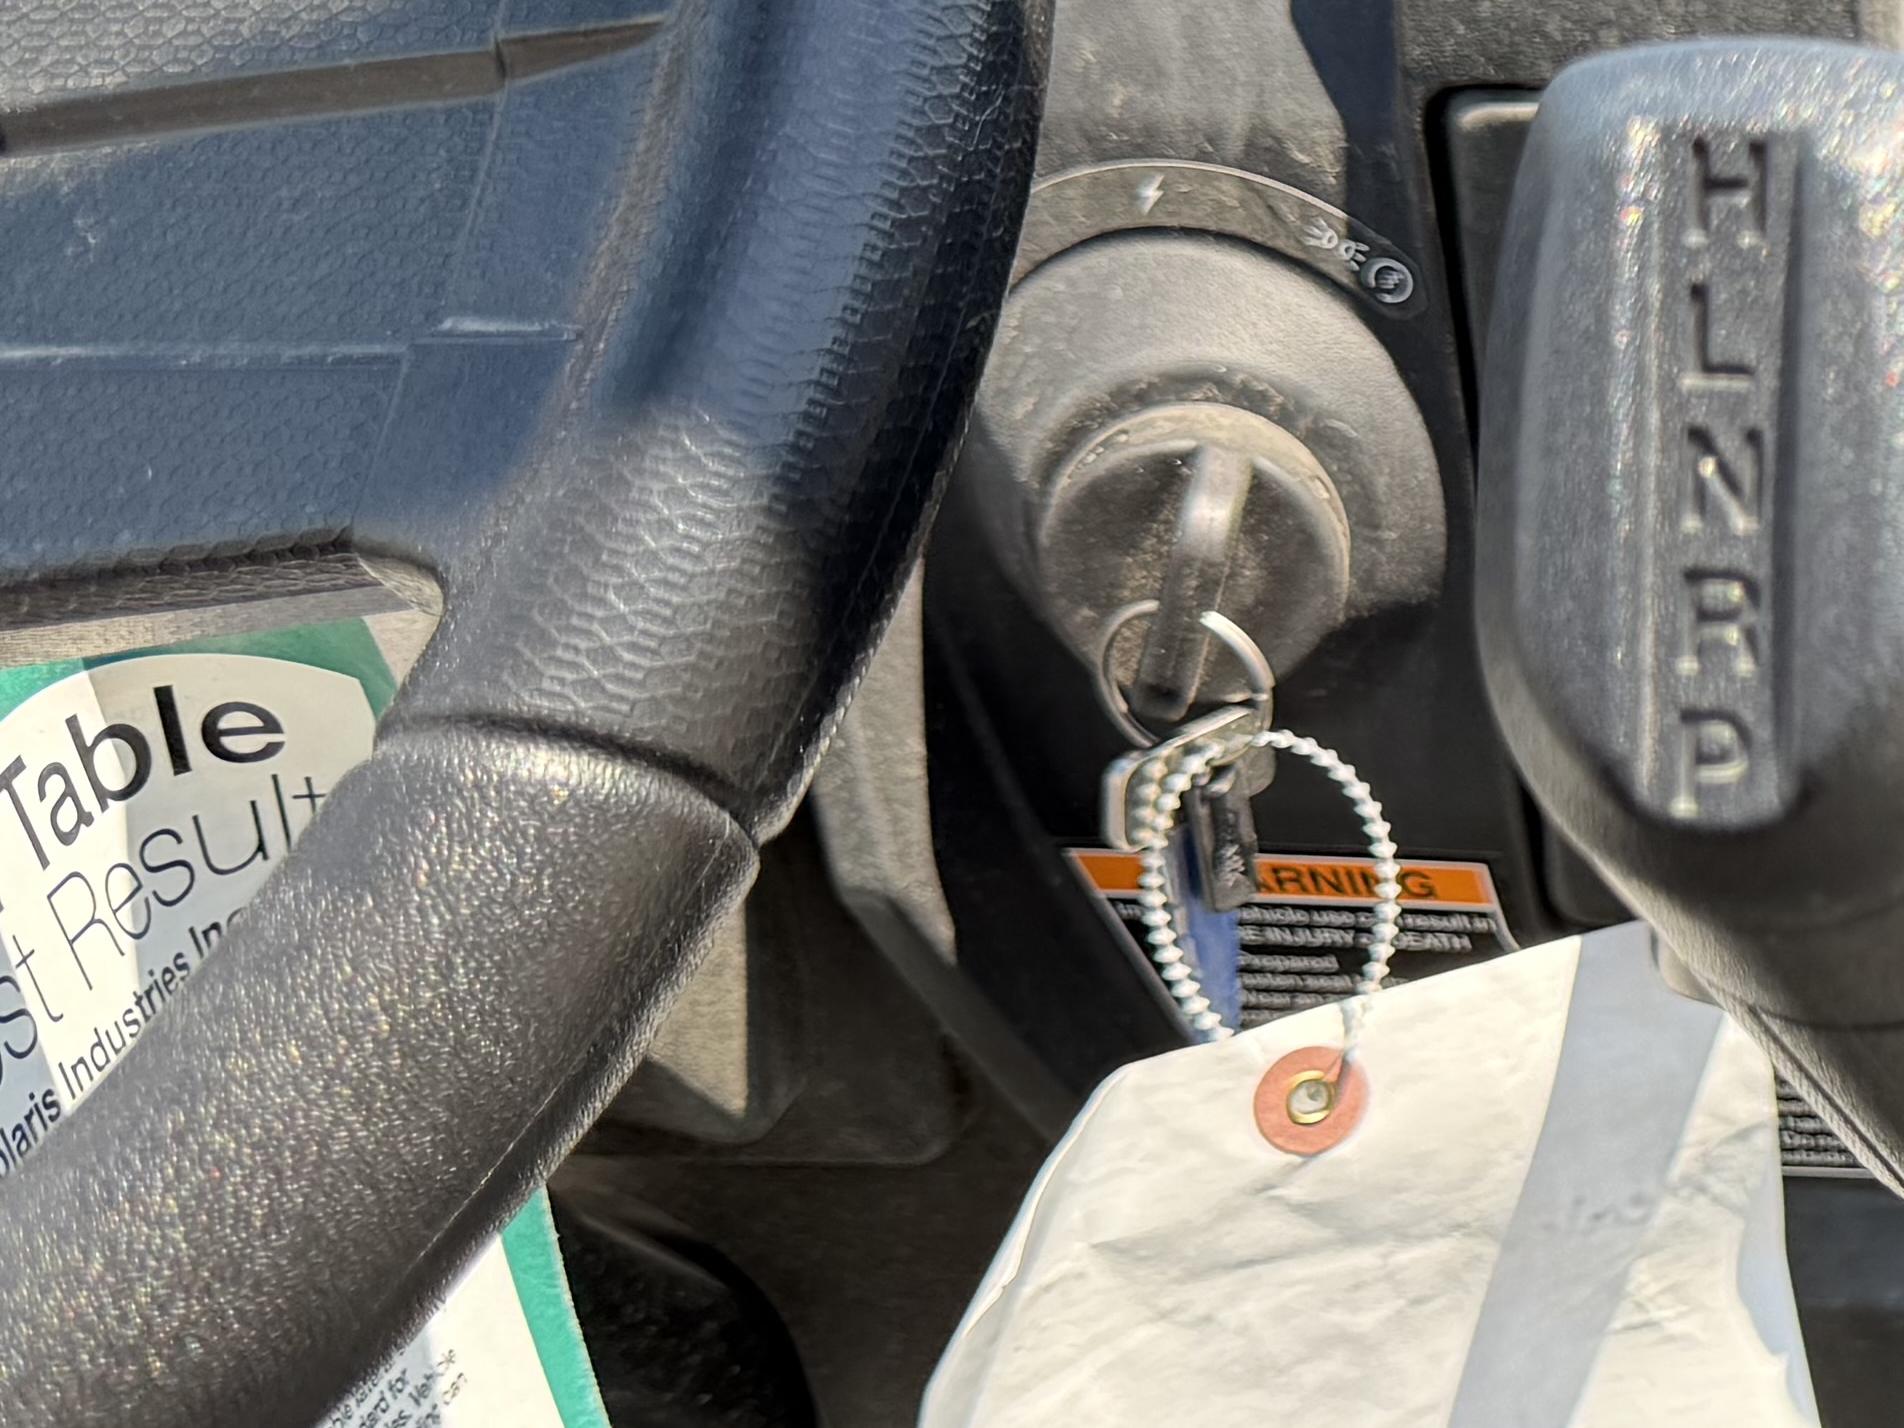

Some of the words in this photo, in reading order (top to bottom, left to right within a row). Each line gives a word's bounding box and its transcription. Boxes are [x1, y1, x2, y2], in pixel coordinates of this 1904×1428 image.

[1684, 136, 1769, 248] H
[1680, 281, 1756, 390] L
[1680, 424, 1763, 537] N
[1676, 566, 1763, 676] R
[0, 684, 285, 871] Table
[1670, 706, 1753, 819] P
[58, 951, 190, 1100] Industries
